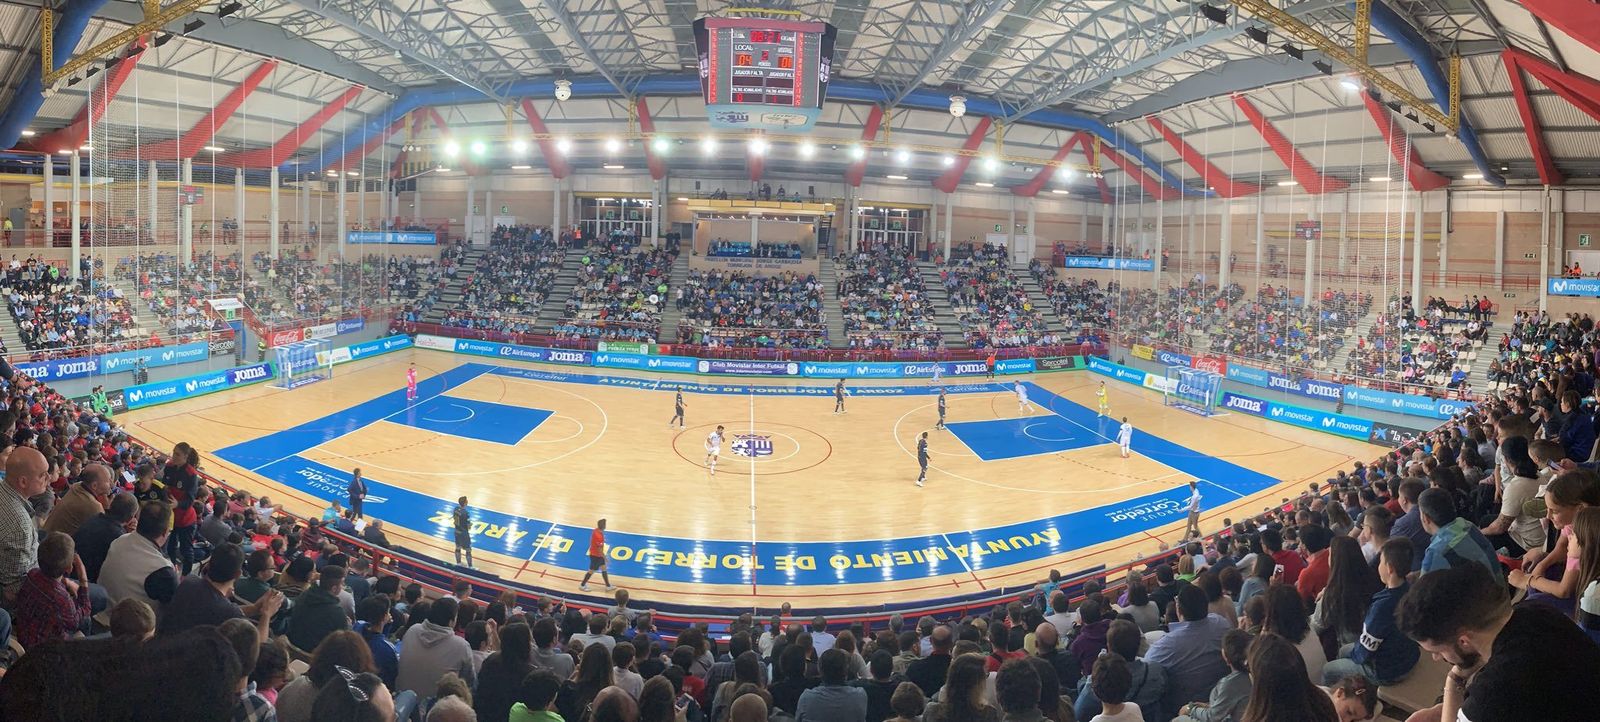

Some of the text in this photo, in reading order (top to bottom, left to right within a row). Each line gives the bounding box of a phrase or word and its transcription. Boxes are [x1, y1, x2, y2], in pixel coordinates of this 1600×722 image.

[1568, 283, 1600, 292] movistar
[175, 347, 204, 358] movistar
[469, 344, 494, 352] movistar
[511, 350, 540, 358] AirEuropa
[610, 356, 640, 364] movistar
[198, 375, 226, 388] movistar
[599, 377, 718, 392] AYUNTAMIENTO
[145, 386, 177, 399] movistar
[1405, 399, 1435, 411] movistar
[1284, 411, 1315, 423] movistar
[1335, 421, 1369, 433] movistar
[1111, 500, 1180, 523] Corredor
[531, 533, 574, 554] DE
[829, 527, 1061, 570] AYUNTAMIENTO
[775, 554, 817, 571] DE
